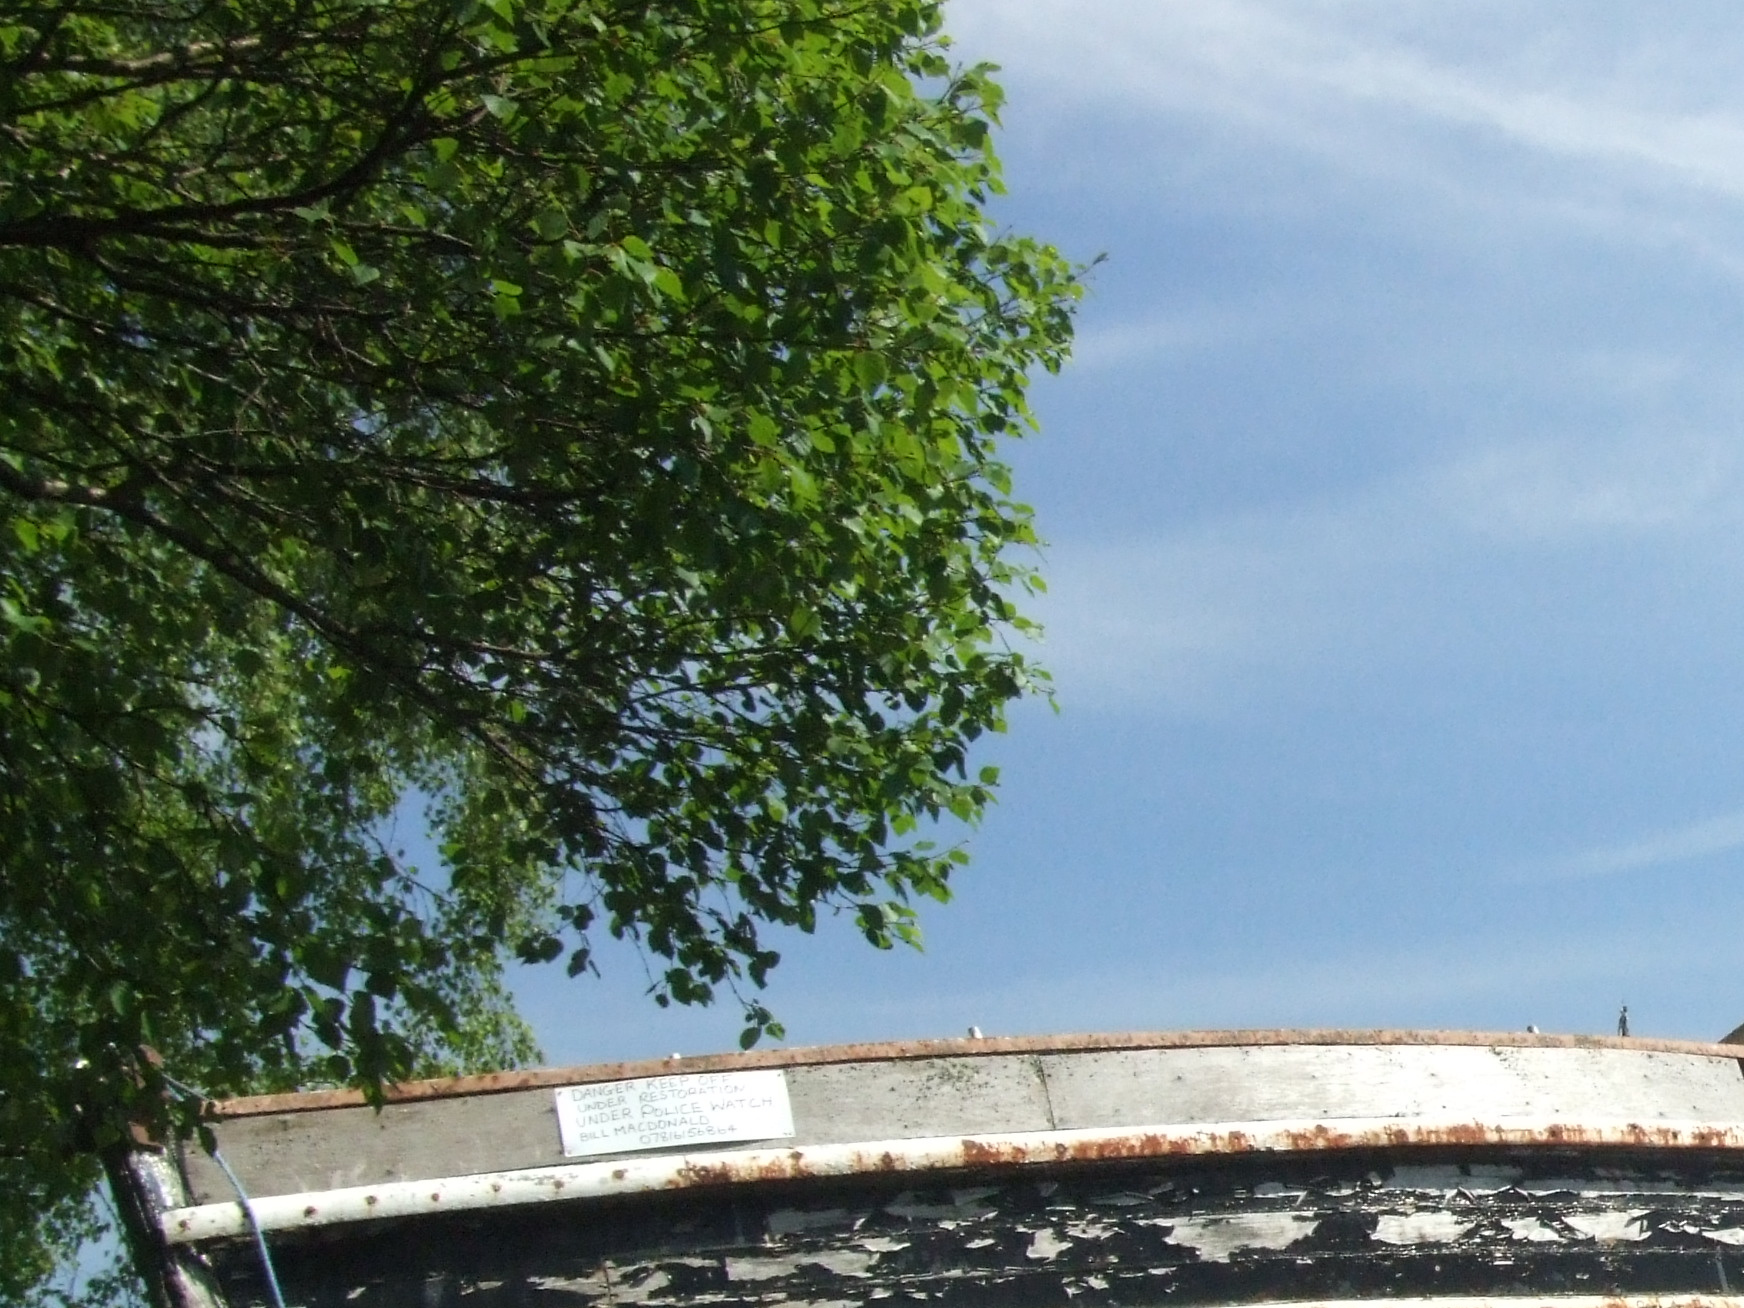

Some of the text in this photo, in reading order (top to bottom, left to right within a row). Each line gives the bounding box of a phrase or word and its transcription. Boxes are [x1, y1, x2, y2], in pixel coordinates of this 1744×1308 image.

[571, 1074, 732, 1102] DANGER KEEP OFF
[577, 1084, 745, 1113] UNDER RESTORATION
[576, 1096, 773, 1128] UNDER POLICE WATCH
[580, 1115, 710, 1142] BILL MACDONALD
